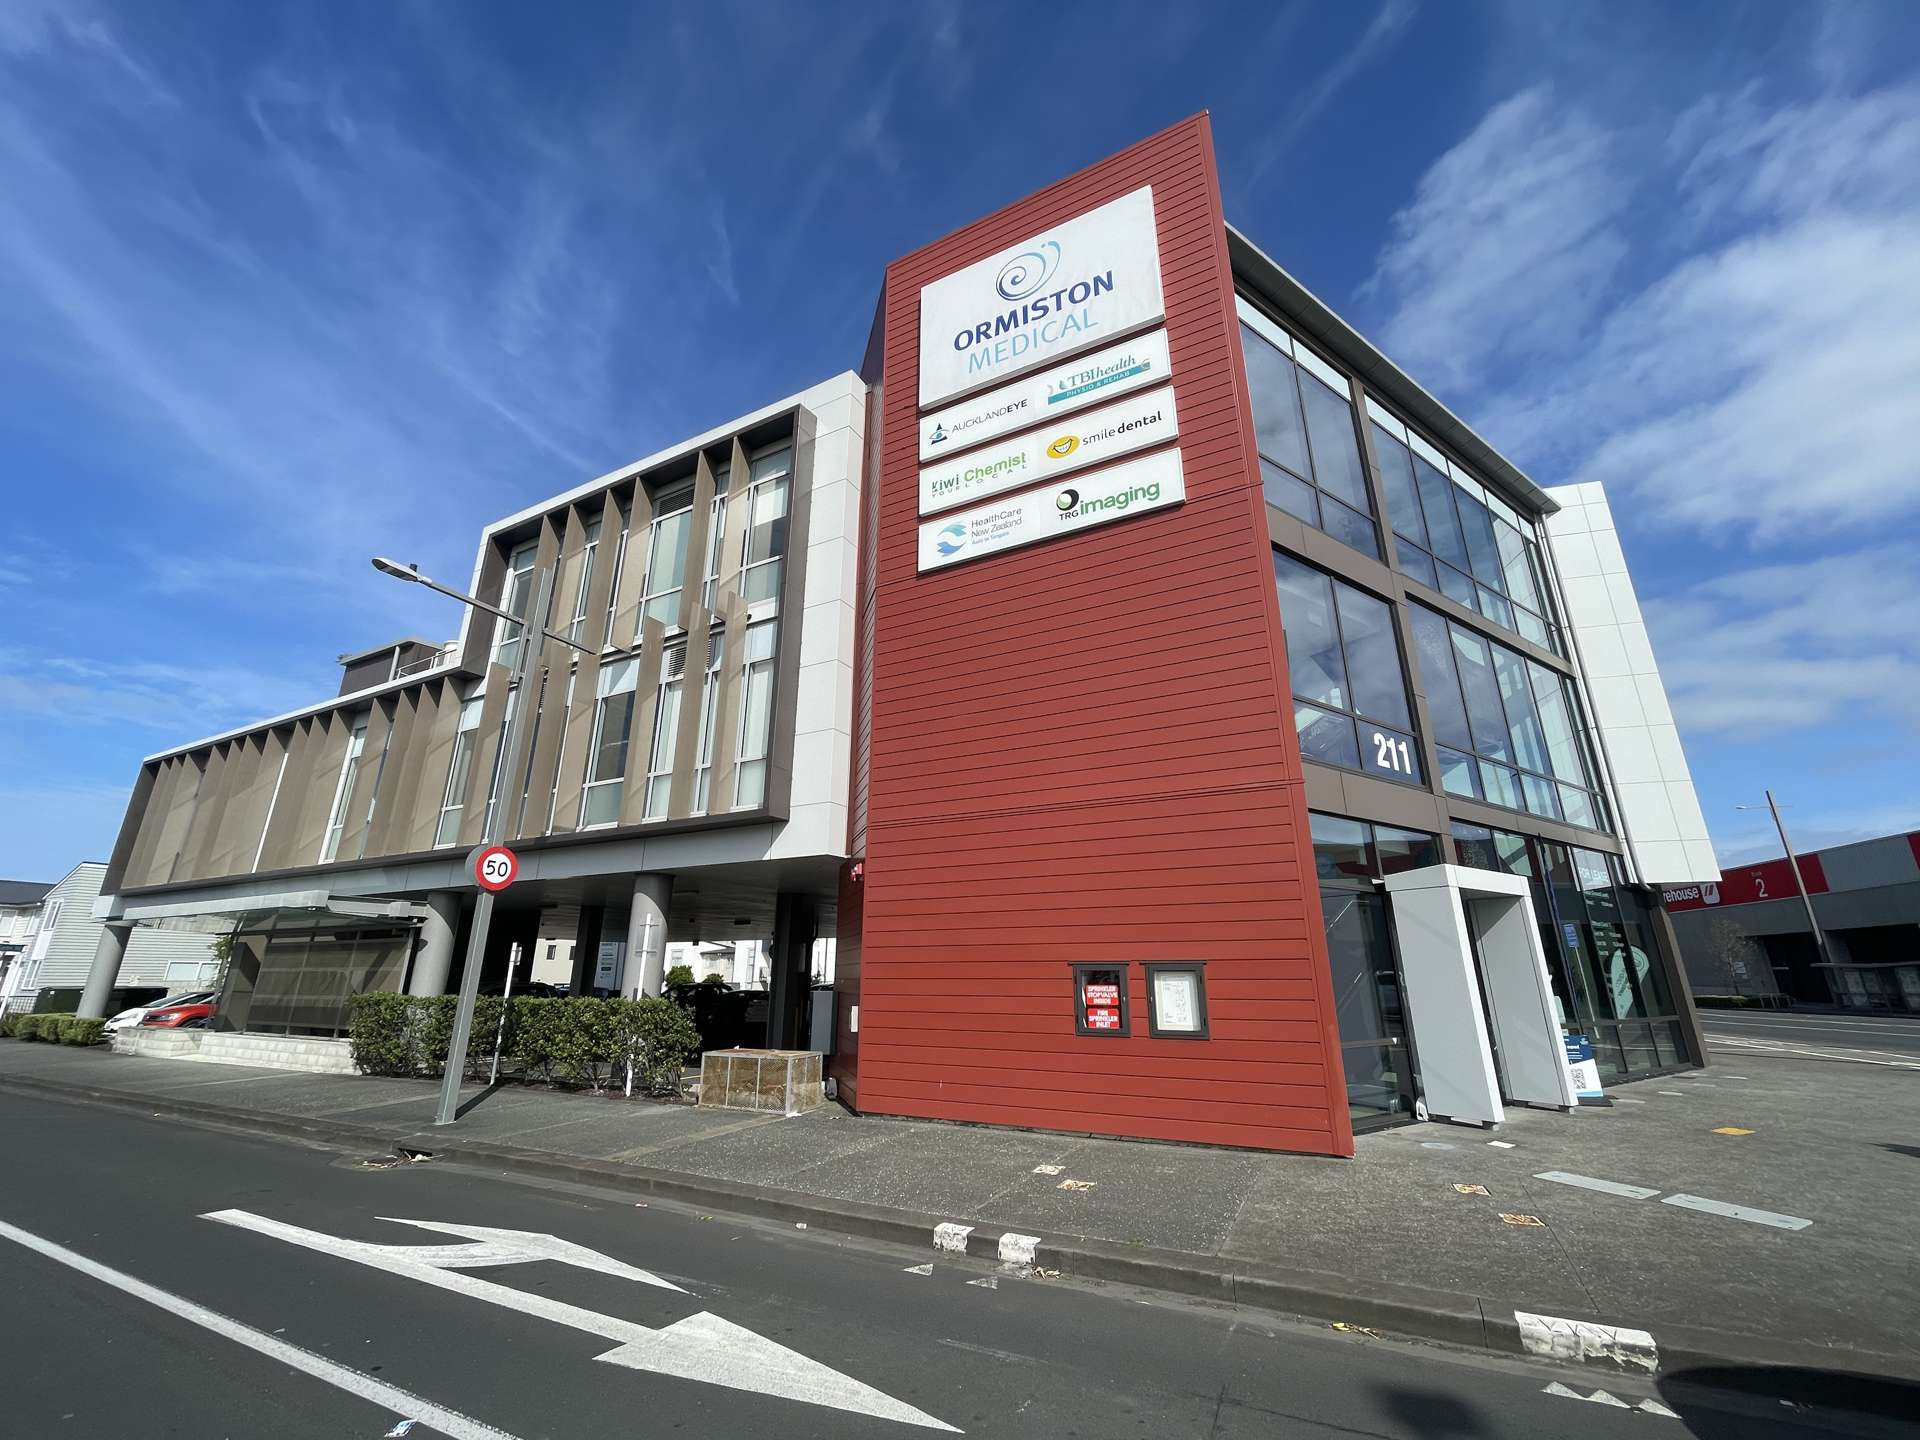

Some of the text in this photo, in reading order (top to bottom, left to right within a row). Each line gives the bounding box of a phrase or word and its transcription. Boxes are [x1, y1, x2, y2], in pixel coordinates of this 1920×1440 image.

[954, 270, 1114, 351] ORMISTON
[969, 308, 1099, 374] MEDICAL
[1066, 384, 1095, 398] PHYSIO
[1103, 371, 1130, 385] REHAB
[952, 399, 1028, 433] AUCKLANDEYE
[932, 452, 1027, 493] Kiwi Chemist
[965, 464, 1027, 488] LOCAL
[1059, 482, 1160, 521] TRG imaging
[971, 528, 990, 539] New
[991, 517, 1023, 533] Zealand
[1374, 732, 1412, 775] 211
[485, 860, 508, 877] 50
[1755, 878, 1768, 898] 2
